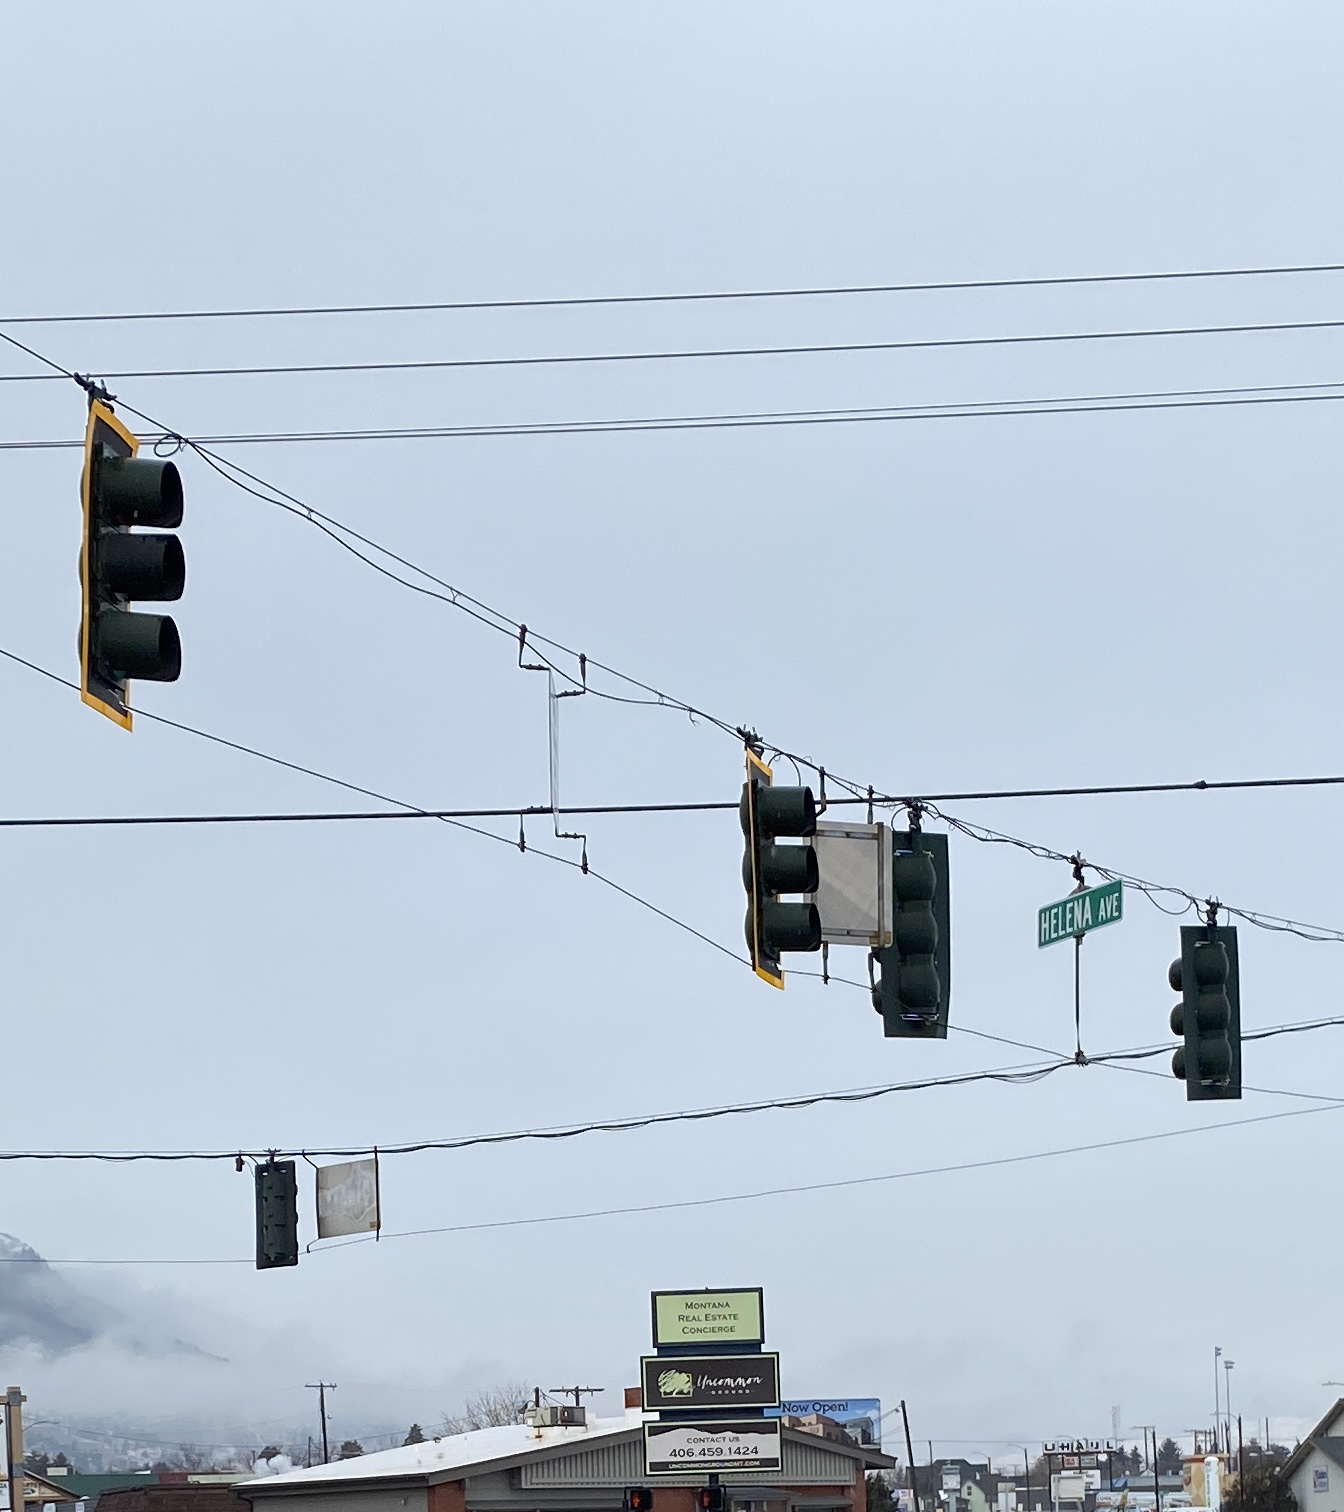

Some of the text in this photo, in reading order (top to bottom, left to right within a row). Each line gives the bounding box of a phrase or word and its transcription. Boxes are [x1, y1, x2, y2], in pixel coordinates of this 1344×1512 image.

[1040, 892, 1120, 943] HELENA AVE
[696, 1374, 764, 1390] Uncommon
[781, 1401, 849, 1415] Now Open!
[686, 1435, 740, 1444] CONTACT US
[668, 1445, 759, 1459] 406.459.1424
